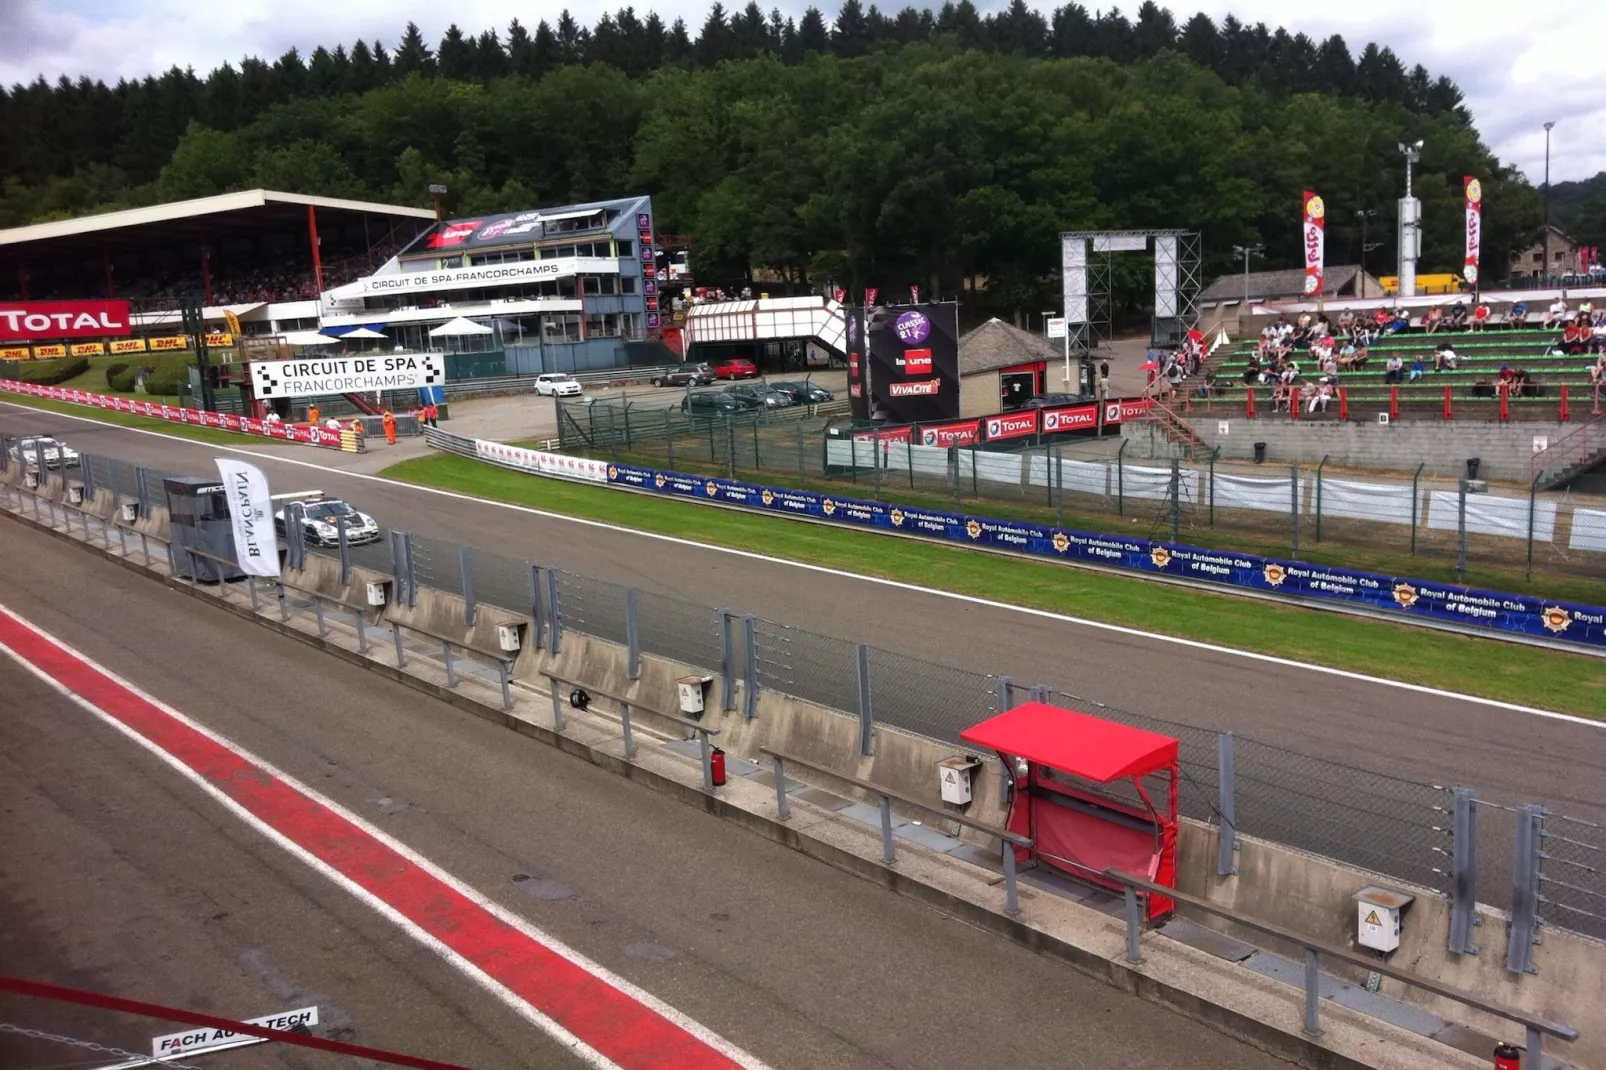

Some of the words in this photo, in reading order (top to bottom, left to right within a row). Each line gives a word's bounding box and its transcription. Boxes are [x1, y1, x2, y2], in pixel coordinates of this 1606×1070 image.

[372, 278, 410, 290] CIRCUIT
[414, 276, 428, 285] DE
[0, 310, 122, 332] TOTAL
[898, 316, 926, 330] CLASSIC
[900, 331, 912, 339] 21
[116, 341, 140, 351] DHL
[156, 338, 179, 348] DHL
[282, 360, 348, 378] CIRCUIT
[354, 359, 376, 373] DE
[384, 358, 417, 371] SPA
[284, 374, 416, 394] FRANCORCHAMPS
[1002, 420, 1032, 430] TOTAL
[1060, 413, 1092, 424] TOTAL
[982, 523, 997, 532] Royal
[998, 525, 1028, 536] Automobile
[1004, 534, 1027, 544] Belgium
[1070, 536, 1087, 545] Royal
[1088, 538, 1124, 550] Automobile
[1125, 544, 1140, 552] Club
[1096, 548, 1122, 558] Belgium
[1172, 550, 1190, 561] Royal
[1192, 553, 1233, 566] Automobile
[1234, 559, 1251, 568] Club
[1201, 563, 1230, 575] Belgium
[1288, 567, 1310, 578] Royal
[1311, 571, 1358, 585] Automobile
[1360, 578, 1379, 588] Club
[1310, 580, 1319, 589] of
[1321, 582, 1354, 594] Belgium
[1420, 588, 1446, 600] Royal
[1448, 592, 1501, 608] Automobile
[1503, 600, 1525, 612] Club
[1446, 602, 1456, 611] of
[1458, 604, 1497, 618] Belgium
[1574, 611, 1603, 624] Royal
[161, 1032, 207, 1050] FACH
